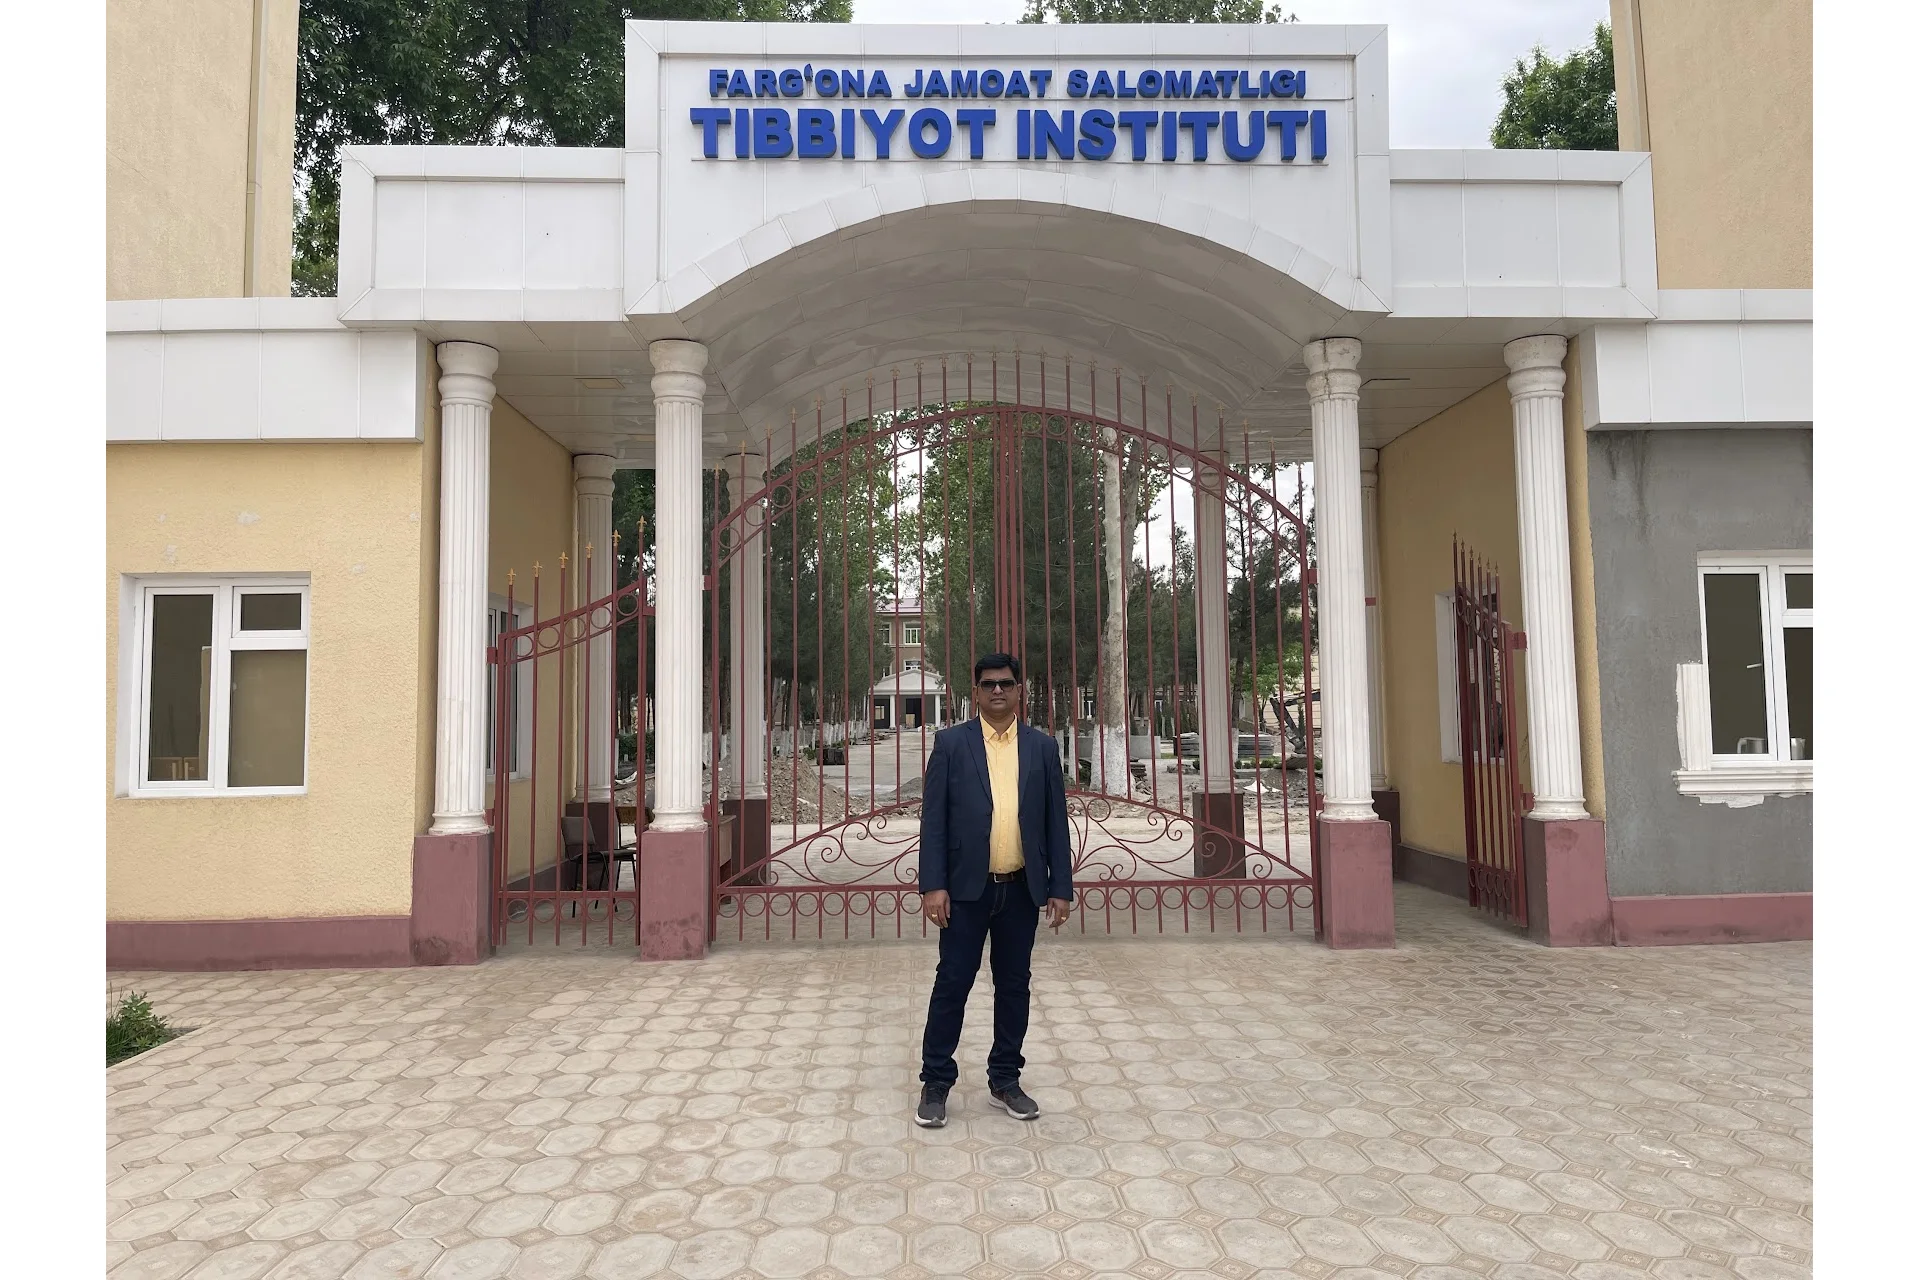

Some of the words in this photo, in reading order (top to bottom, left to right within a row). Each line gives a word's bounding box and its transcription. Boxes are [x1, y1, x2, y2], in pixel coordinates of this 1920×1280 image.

[904, 69, 1053, 98] JAMOAT
[1067, 69, 1307, 98] SALOMATLIGI
[690, 107, 997, 160] TIBBIYOT
[1016, 109, 1328, 162] INSTITUTI
